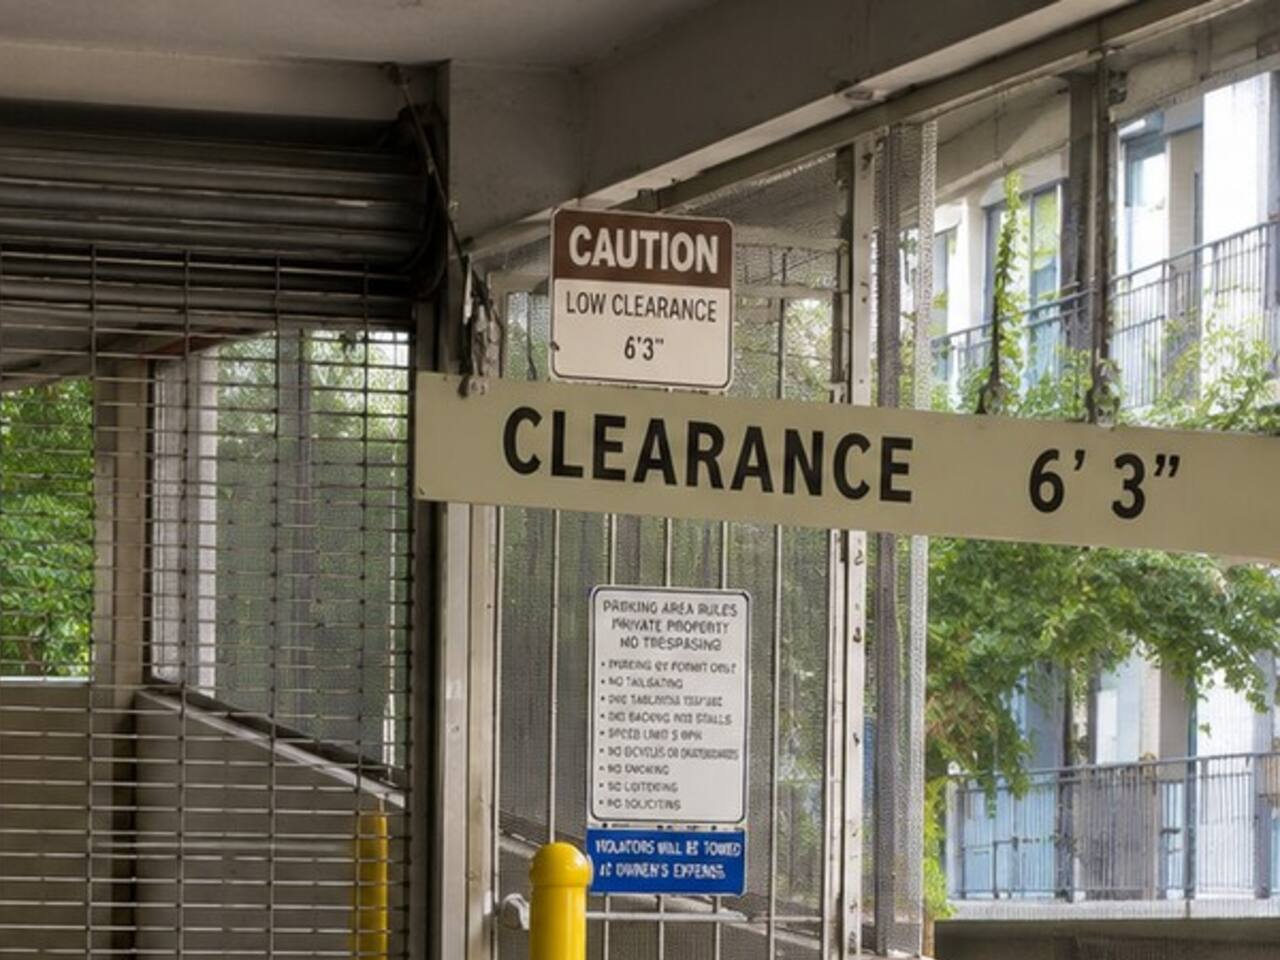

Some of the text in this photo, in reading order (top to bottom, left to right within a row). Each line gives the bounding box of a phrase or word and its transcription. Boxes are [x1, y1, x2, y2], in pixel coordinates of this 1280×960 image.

[570, 225, 718, 274] CAUTION
[567, 291, 717, 323] LOW CLEARANCE
[503, 406, 914, 503] CLEARANCE
[603, 600, 738, 617] PARKING AREA RULES
[611, 618, 729, 634] PRIVATE PROPERTY
[620, 636, 638, 649] NO
